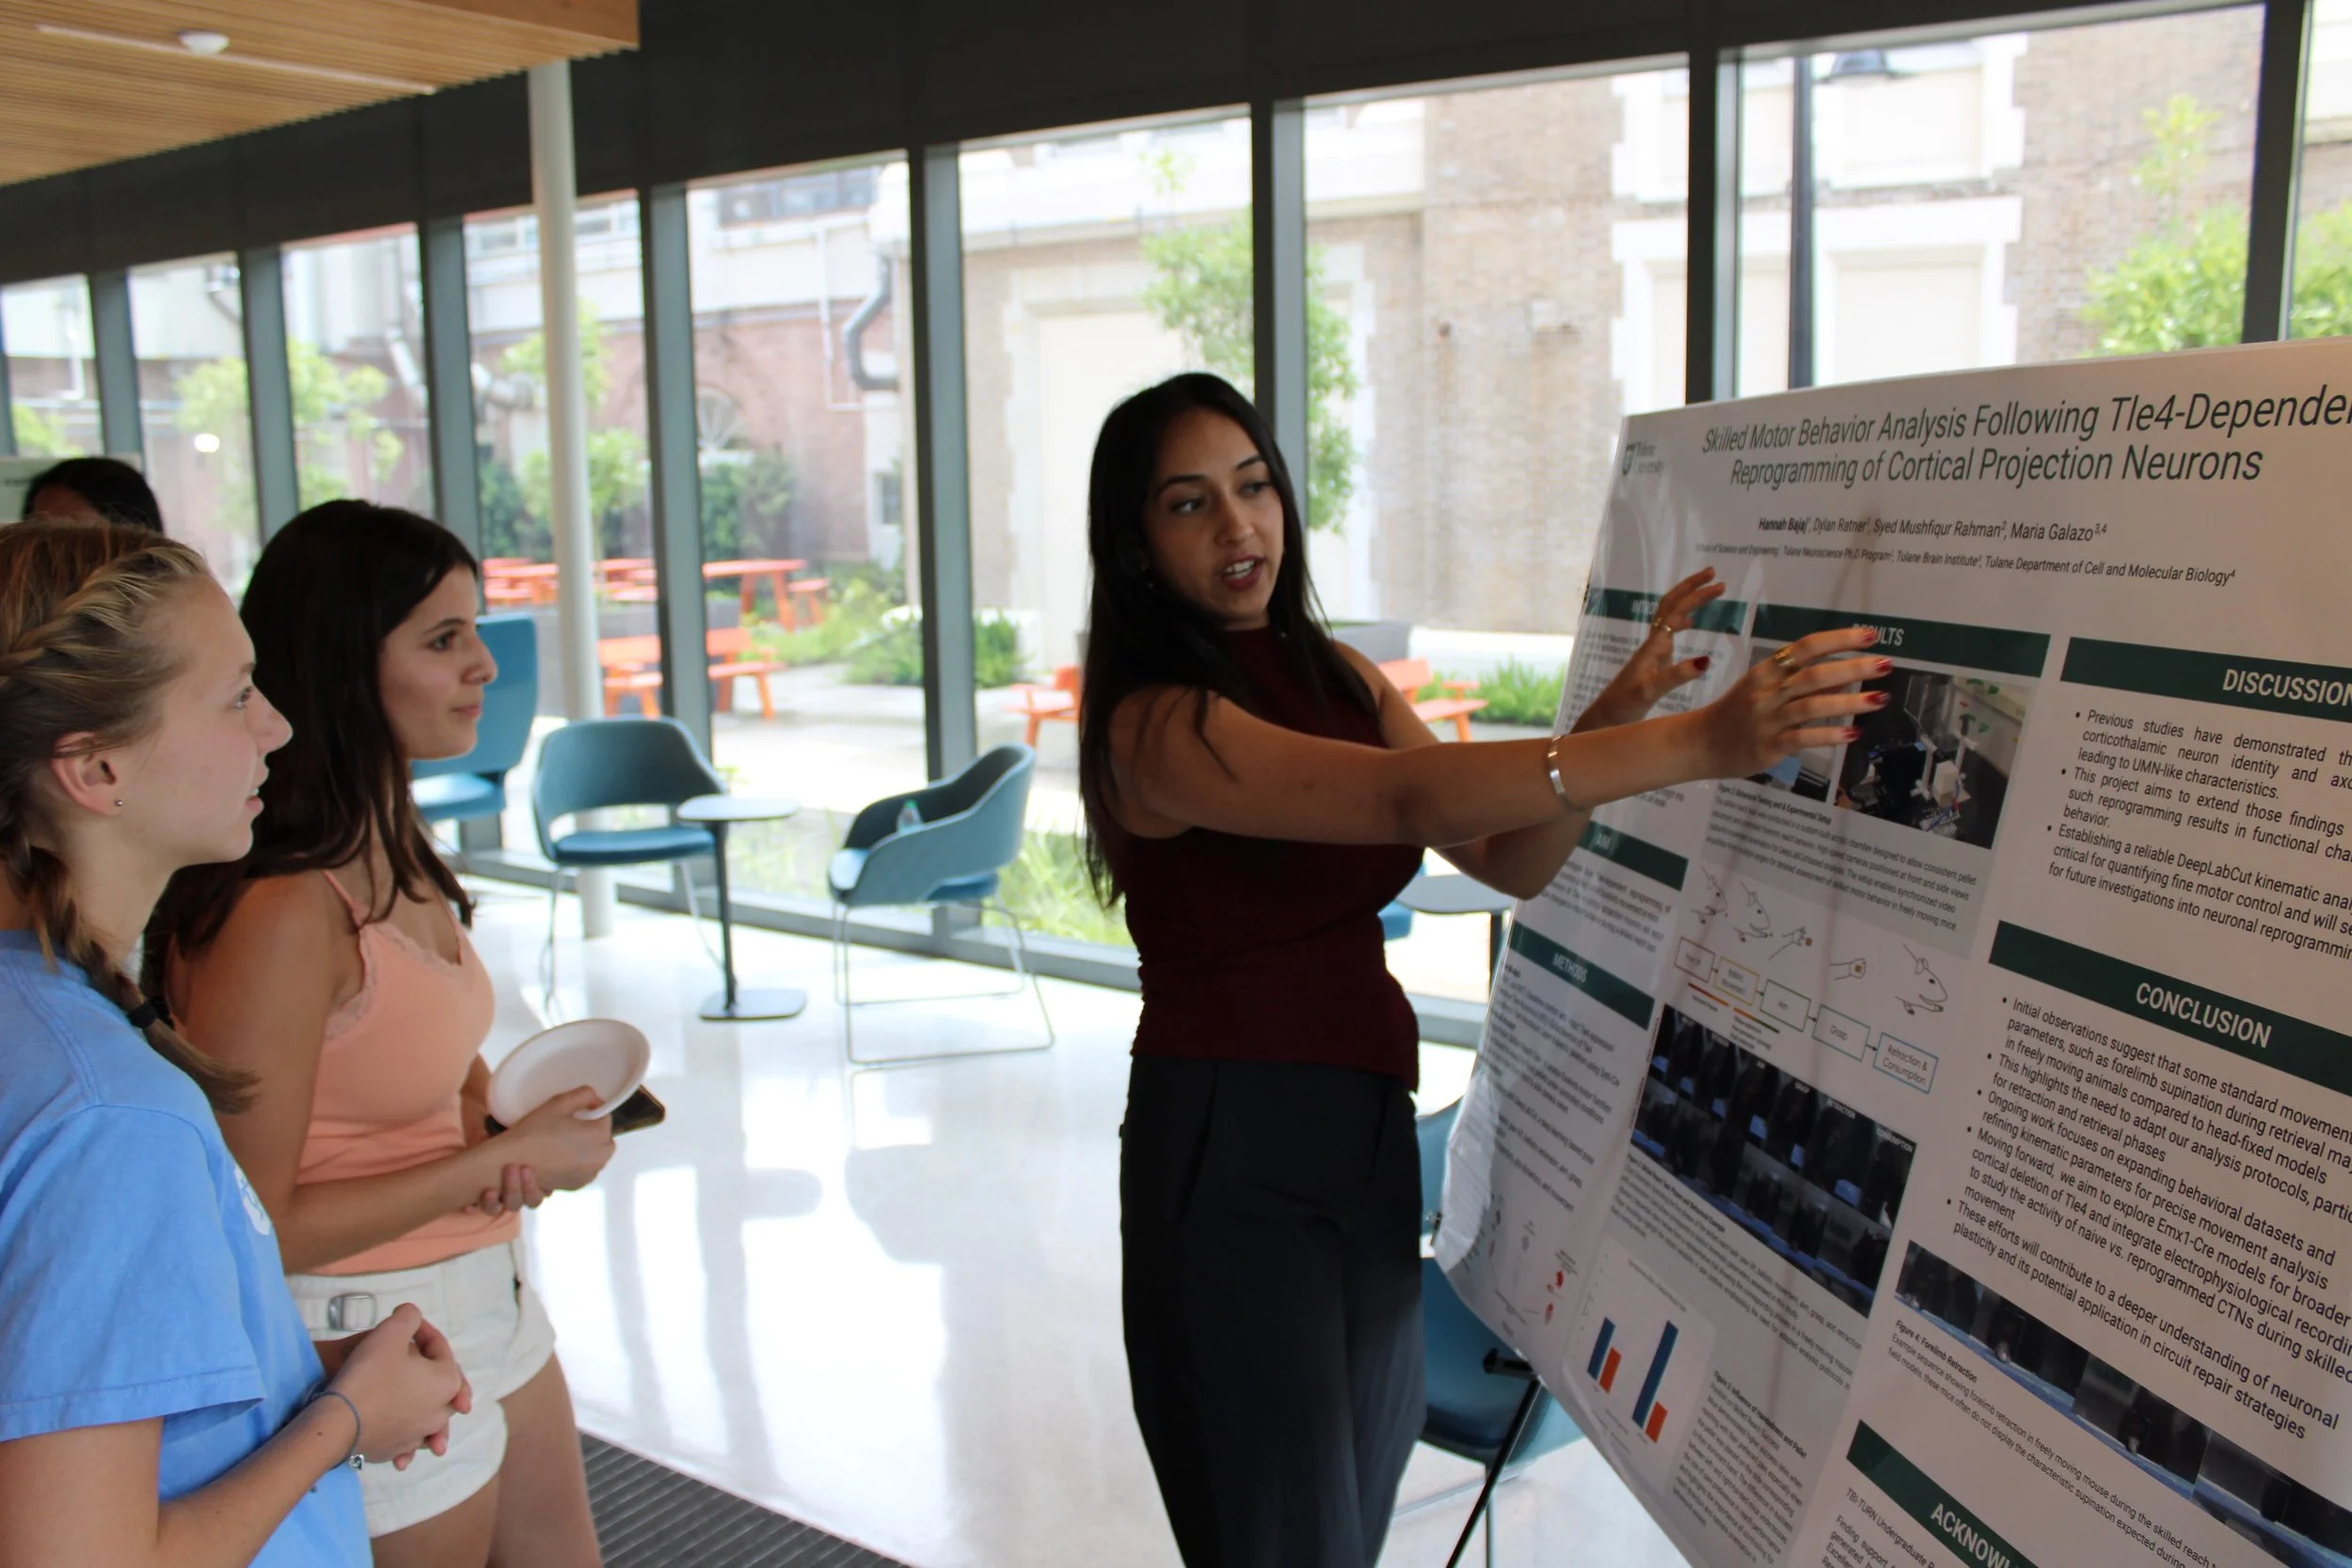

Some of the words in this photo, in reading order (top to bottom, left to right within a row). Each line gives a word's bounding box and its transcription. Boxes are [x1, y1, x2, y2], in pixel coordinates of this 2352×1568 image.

[1702, 425, 1748, 453] Skilled
[1749, 423, 1796, 450] Motor
[1798, 415, 1876, 447] Behavior
[1877, 407, 1967, 448] Analysis
[1972, 400, 2100, 442] Following
[2111, 384, 2352, 438] Tle4-Depende
[1730, 457, 1859, 491] Reprogramming
[1862, 450, 1887, 482] of
[1887, 447, 1975, 482] Cortical
[1979, 445, 2113, 489] Projection
[2121, 444, 2263, 481] Neurons
[1758, 517, 1788, 531] Hannah
[1813, 518, 1836, 533] Dylan
[1873, 518, 1898, 536] Syed
[1899, 519, 1952, 539] Mushfiqur
[2010, 522, 2044, 540] Maria
[1897, 549, 1921, 563] Tulane
[1921, 551, 1943, 564] Brain
[1985, 555, 2014, 569] Tulane
[2015, 557, 2071, 572] Department
[2071, 560, 2084, 573] of
[2084, 561, 2106, 575] Cell
[2106, 563, 2126, 577] and
[2127, 563, 2185, 580] Molecular
[2082, 730, 2168, 755] corticothalamic
[2177, 747, 2219, 766] neuron
[2230, 755, 2280, 780] identity
[2290, 768, 2319, 784] and
[2087, 708, 2134, 730] Previous
[2142, 720, 2185, 738] studies
[2193, 725, 2223, 745] have
[2233, 733, 2328, 762] demonstrated
[2074, 766, 2096, 784] This
[2099, 774, 2139, 793] project
[2143, 782, 2172, 800] aims
[2177, 788, 2191, 803] to
[2196, 794, 2241, 814] extend
[2245, 801, 2282, 823] those
[2288, 810, 2344, 838] findings
[2077, 746, 2117, 770] leading
[2118, 755, 2130, 769] to
[2132, 757, 2184, 781] UMN-like
[2185, 768, 2279, 800] characteristics.
[2062, 803, 2110, 828] behavior.
[2067, 788, 2094, 803] such
[2097, 795, 2183, 827] reprogramming
[2186, 815, 2230, 834] results
[2233, 822, 2247, 839] in
[2251, 825, 2321, 855] functional
[2053, 845, 2090, 863] critical
[2090, 851, 2107, 868] for
[2106, 859, 2169, 889] quantifying
[2170, 873, 2194, 893] fine
[2194, 882, 2234, 903] motor
[2235, 894, 2283, 916] control
[2282, 906, 2312, 924] and
[2312, 913, 2339, 931] will
[2058, 822, 2122, 855] Establishing
[2123, 842, 2132, 854] a
[2133, 844, 2175, 865] reliable
[2176, 852, 2253, 885] DeepLabCut
[2253, 871, 2320, 902] kinematic
[2048, 861, 2065, 878] for
[2065, 865, 2097, 887] future
[2098, 879, 2175, 910] investigations
[2176, 897, 2201, 917] into
[2201, 908, 2259, 933] neuronal
[2136, 982, 2272, 1049] CONCLUSION
[2012, 997, 2042, 1019] Initial
[2042, 1010, 2108, 1046] observations
[2109, 1037, 2156, 1066] suggest
[2156, 1053, 2182, 1076] that
[2182, 1067, 2217, 1090] some
[2218, 1081, 2279, 1114] standard
[2004, 1038, 2015, 1051] in
[2016, 1039, 2045, 1066] freely
[2045, 1054, 2084, 1083] moving
[2084, 1071, 2128, 1099] animals
[2129, 1091, 2190, 1125] compared
[2190, 1114, 2204, 1132] to
[2205, 1118, 2275, 1162] head-fixed
[2274, 1152, 2328, 1184] models
[1987, 1090, 2029, 1123] Ongoing
[2030, 1112, 2056, 1132] work
[2056, 1121, 2099, 1153] focuses
[2099, 1145, 2115, 1161] on
[2116, 1153, 2177, 1194] expanding
[2177, 1178, 2243, 1222] behavioral
[2243, 1212, 2304, 1251] datasets
[2305, 1243, 2337, 1266] and
[1977, 1127, 2013, 1159] Moving
[2014, 1145, 2055, 1179] forward,
[2059, 1170, 2076, 1187] we
[2076, 1180, 2098, 1198] aim
[2099, 1189, 2111, 1205] to
[2112, 1198, 2155, 1227] explore
[2155, 1216, 2215, 1259] Emx1-Cre
[2216, 1250, 2266, 1285] models
[2268, 1274, 2291, 1297] for
[2291, 1284, 2352, 1327] broader
[1952, 1222, 1997, 1257] plasticity
[1996, 1247, 2018, 1266] and
[2016, 1256, 2030, 1275] its
[2029, 1267, 2078, 1303] potential
[2076, 1295, 2138, 1340] application
[2138, 1329, 2152, 1348] in
[2153, 1340, 2192, 1372] circuit
[2192, 1364, 2233, 1396] repair
[2233, 1388, 2306, 1439] strategies
[1958, 1199, 1987, 1227] These
[1987, 1219, 2021, 1246] efforts
[2021, 1238, 2041, 1257] will
[2039, 1250, 2093, 1289] contribute
[2094, 1279, 2106, 1296] to
[2106, 1289, 2116, 1302] a
[2116, 1292, 2158, 1325] deeper
[2158, 1318, 2250, 1384] understanding
[2252, 1373, 2271, 1390] of
[2269, 1383, 2340, 1430] neuronal
[1877, 1516, 1927, 1566] Undergraduate
[2074, 1488, 2116, 1524] supination
[2115, 1518, 2156, 1552] expected
[2081, 1474, 2110, 1499] mouse
[2109, 1493, 2137, 1520] during
[2137, 1512, 2153, 1529] the
[2152, 1524, 2183, 1550] skilled
[2182, 1544, 2210, 1568] reach
